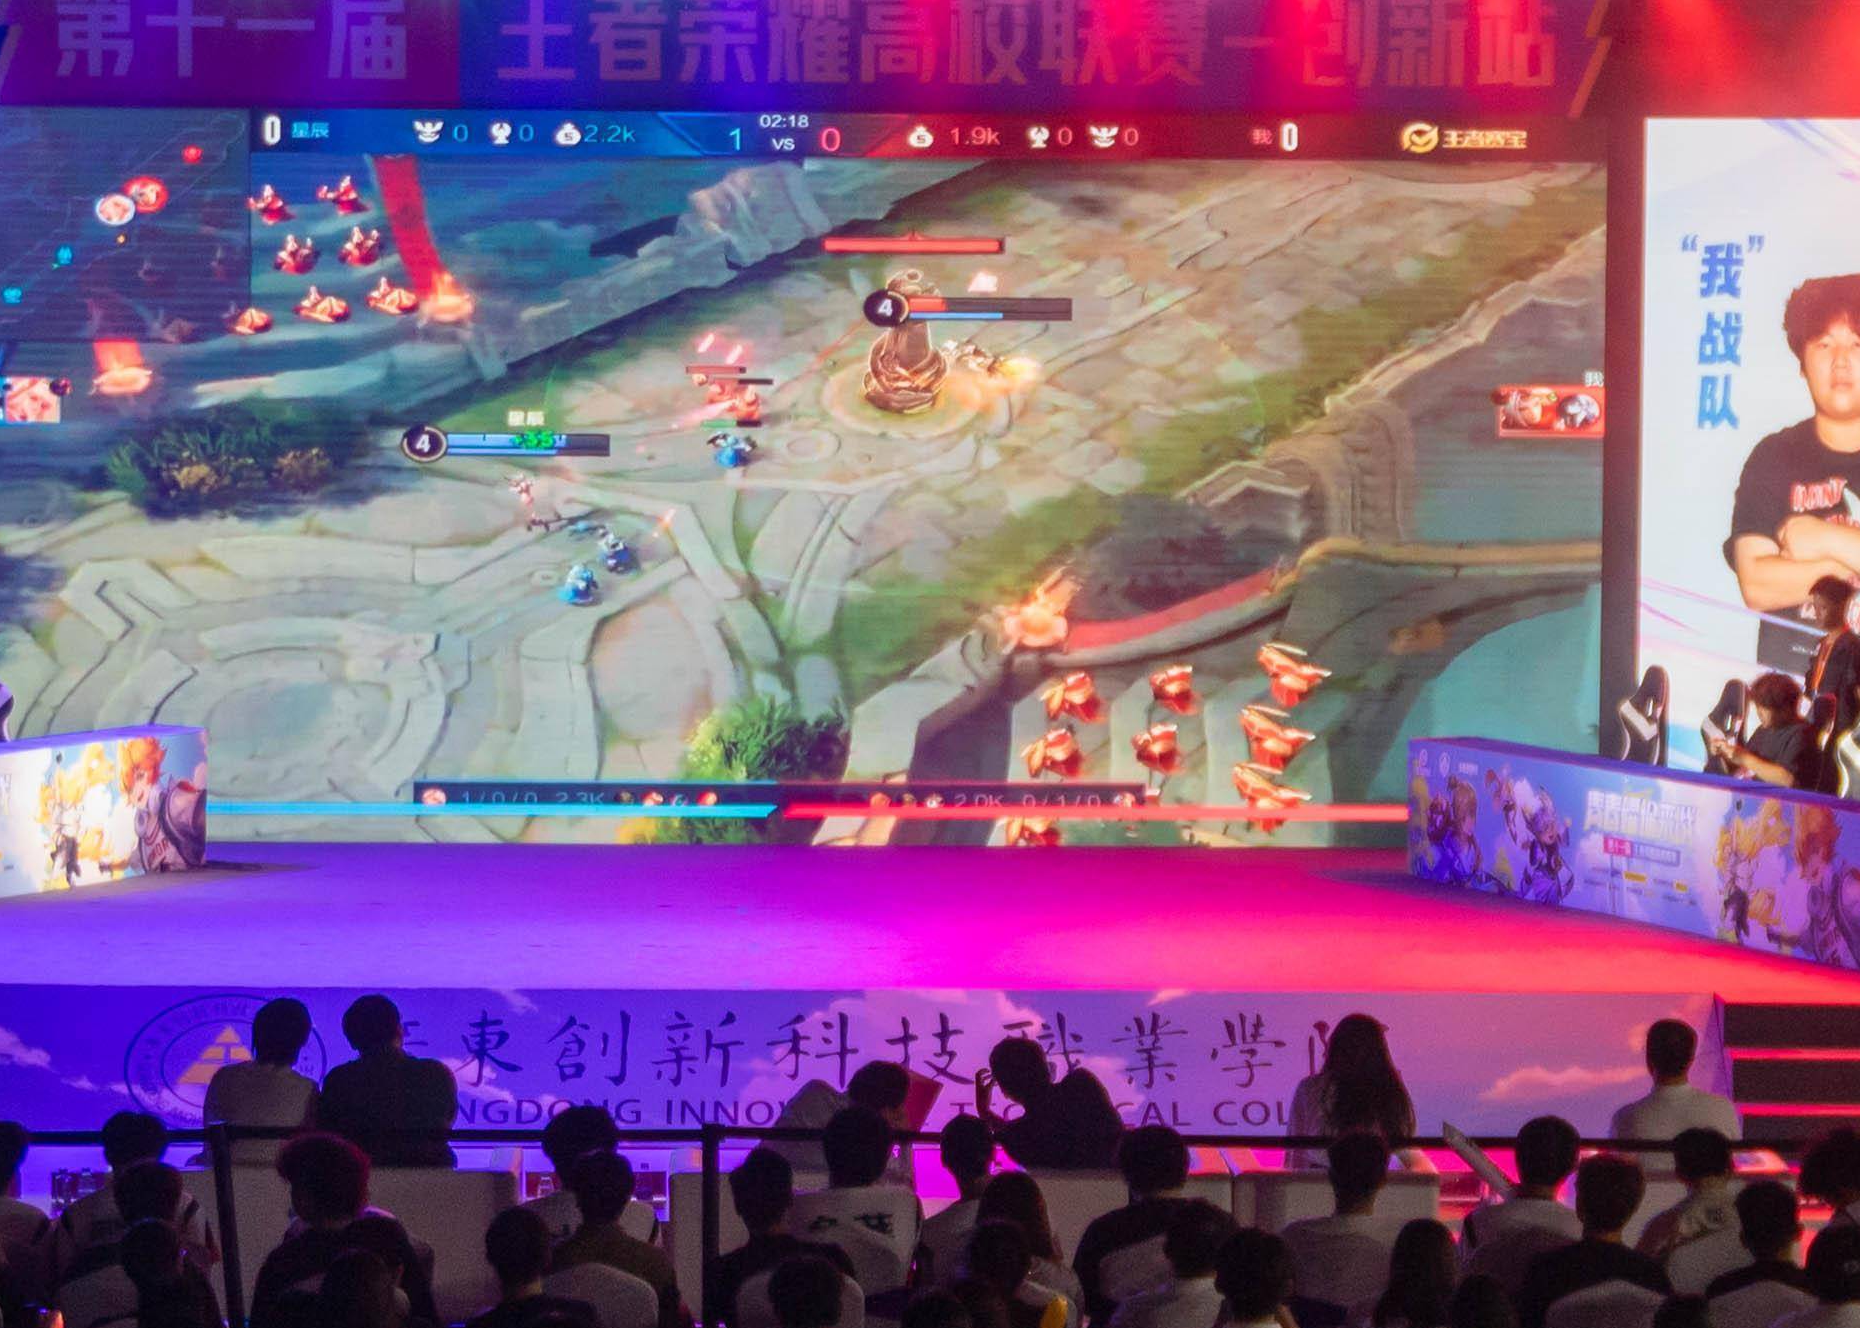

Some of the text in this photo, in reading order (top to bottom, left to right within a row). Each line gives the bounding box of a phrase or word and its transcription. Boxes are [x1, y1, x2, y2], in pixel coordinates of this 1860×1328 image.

[264, 115, 329, 145] 0 星辰
[759, 115, 809, 128] 02:18
[453, 124, 468, 142] 0
[519, 124, 534, 142] 0
[729, 128, 740, 151] 1
[821, 128, 840, 151] 0
[1057, 127, 1072, 145] 0
[1124, 127, 1138, 145] 0
[1281, 123, 1298, 151] 0
[878, 298, 893, 316] 4
[416, 434, 431, 453] 4
